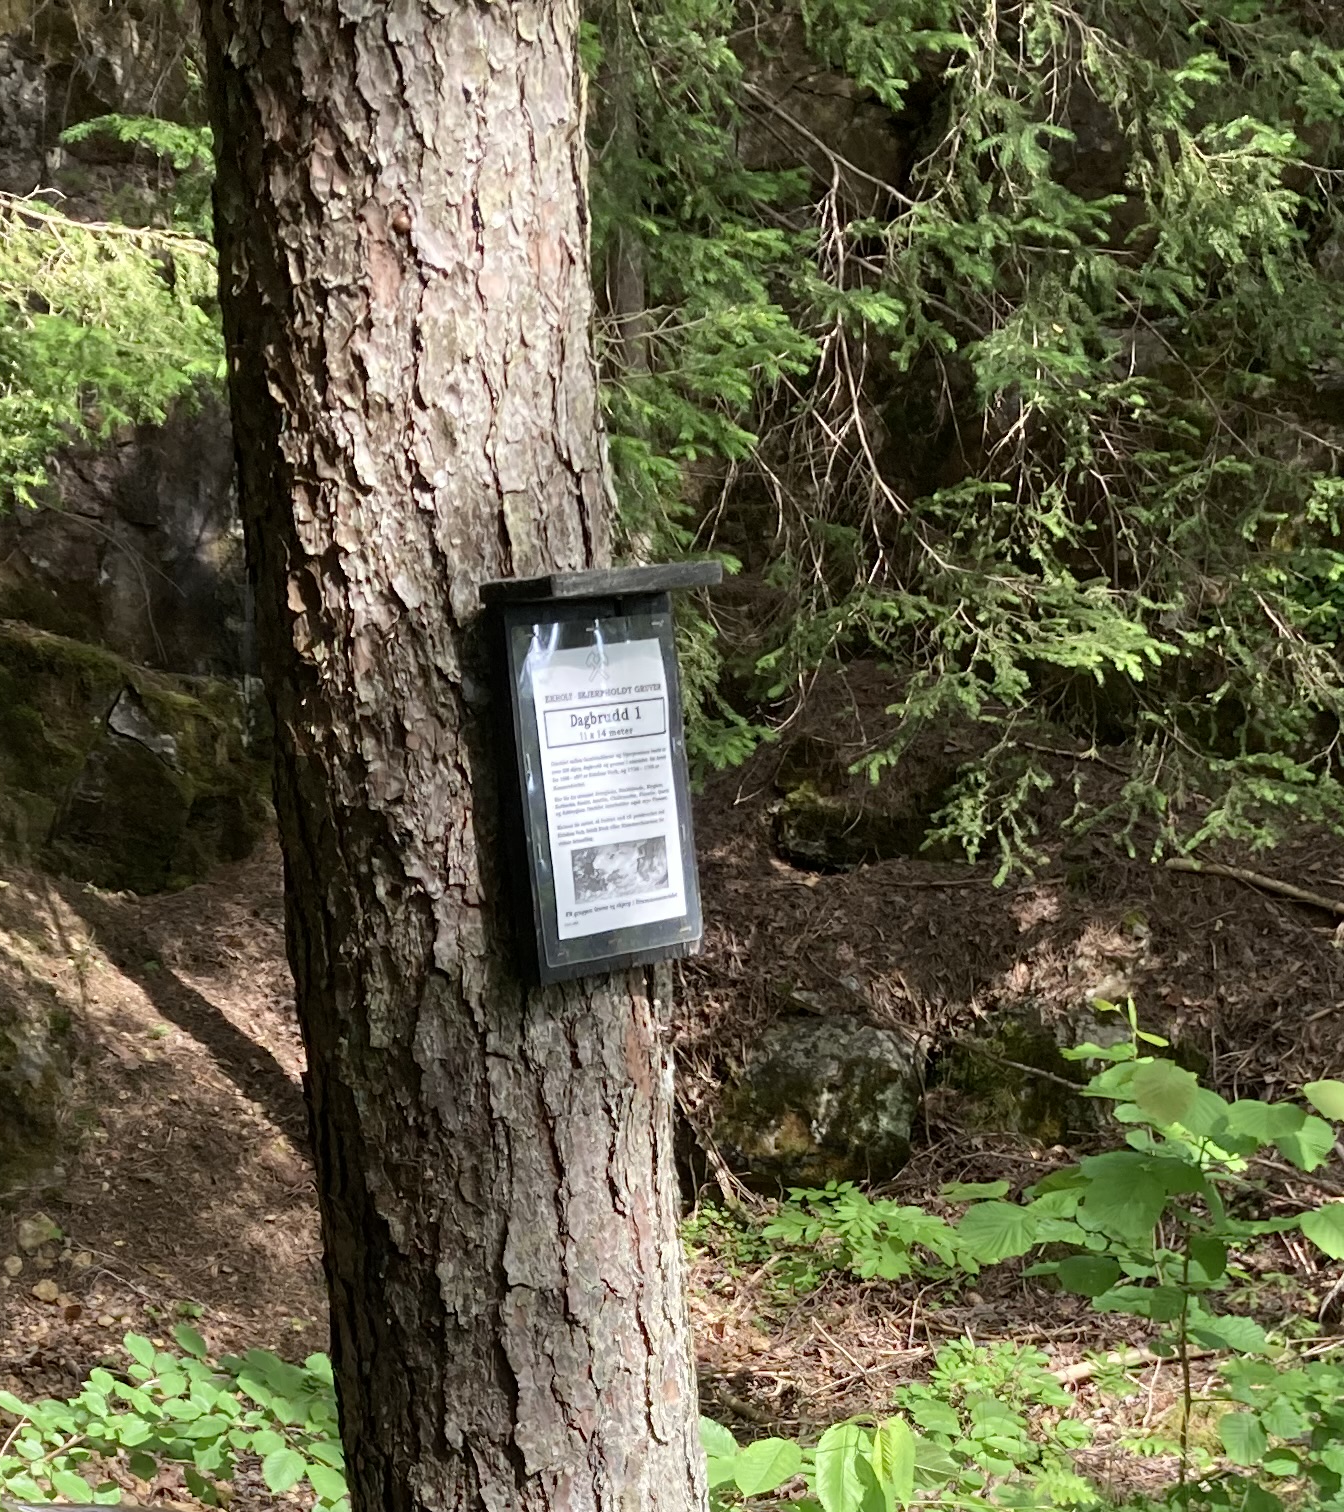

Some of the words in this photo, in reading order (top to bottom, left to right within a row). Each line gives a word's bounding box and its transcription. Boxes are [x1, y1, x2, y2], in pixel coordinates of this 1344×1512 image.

[570, 708, 629, 729] Dagbrudd
[634, 706, 642, 720] 1
[608, 727, 634, 737] meter
